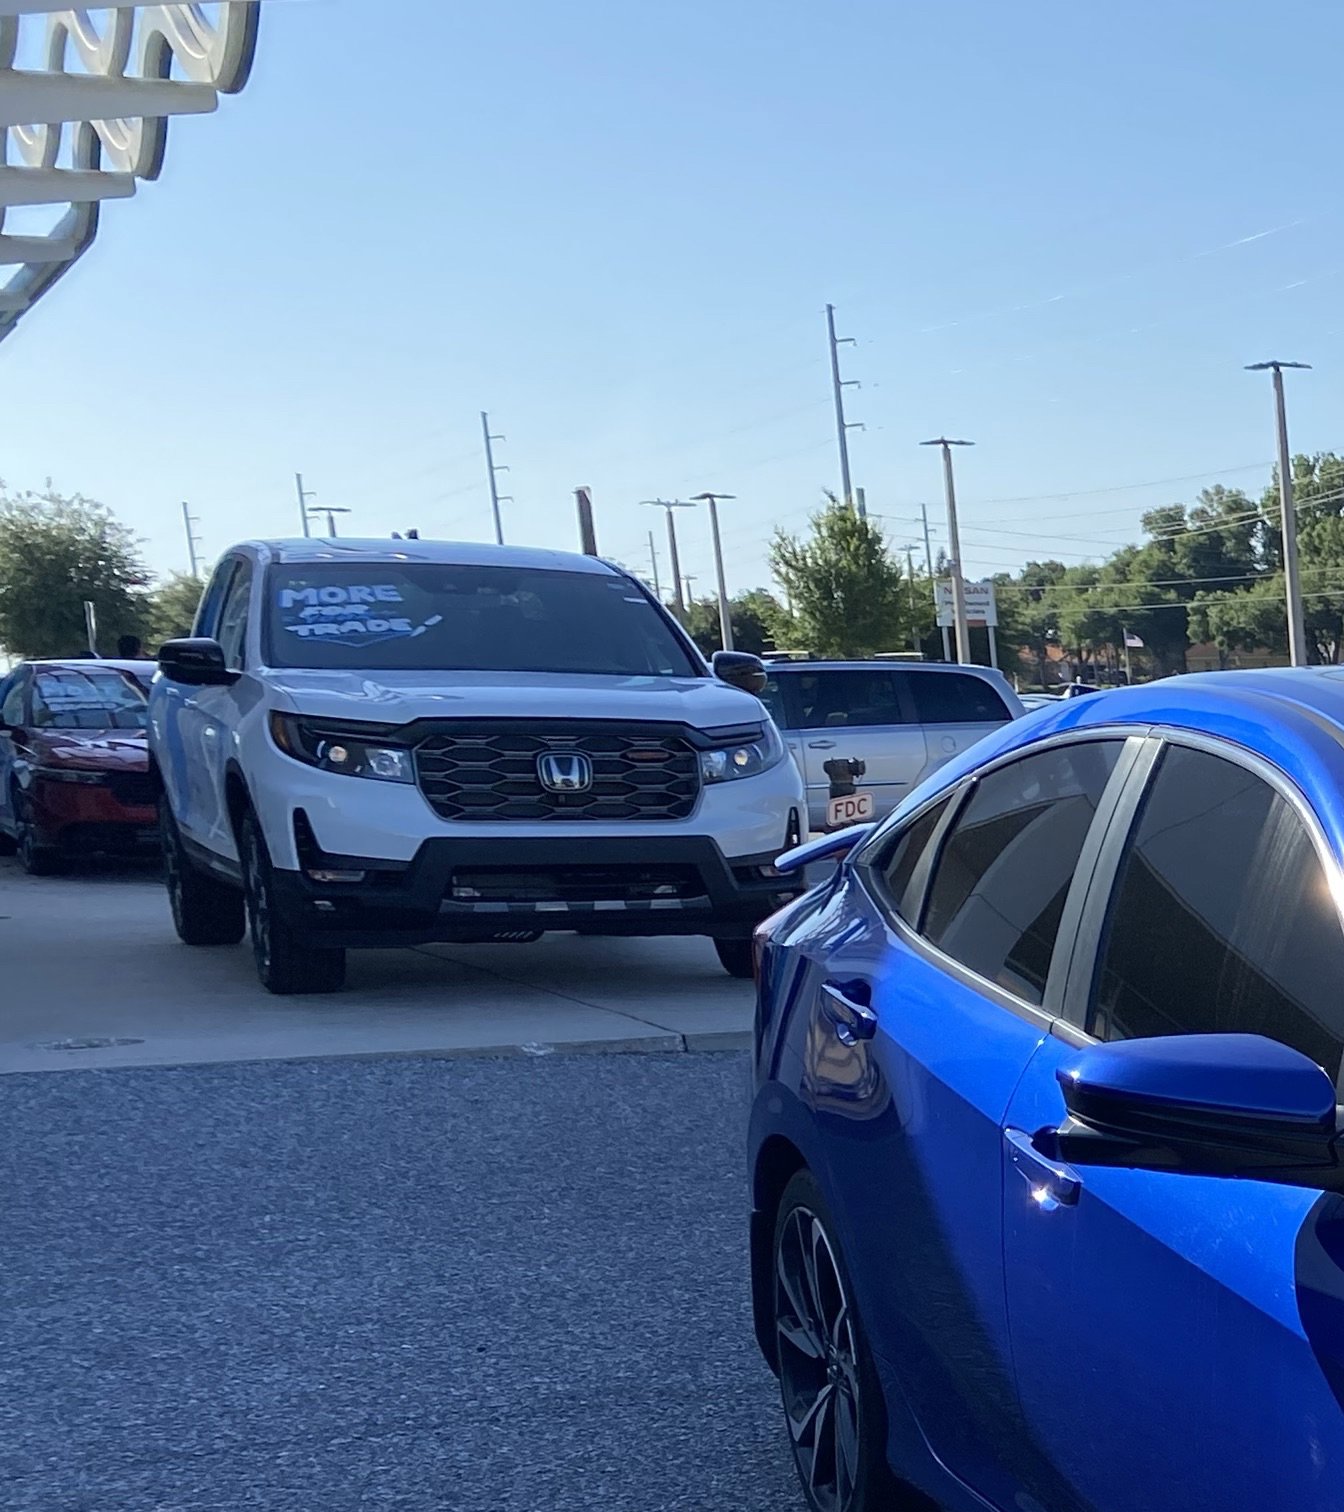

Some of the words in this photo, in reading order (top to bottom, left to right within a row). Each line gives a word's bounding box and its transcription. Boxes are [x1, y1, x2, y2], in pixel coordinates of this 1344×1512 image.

[278, 584, 404, 608] MORE
[299, 604, 369, 618] FOR
[834, 798, 867, 820] FDC
